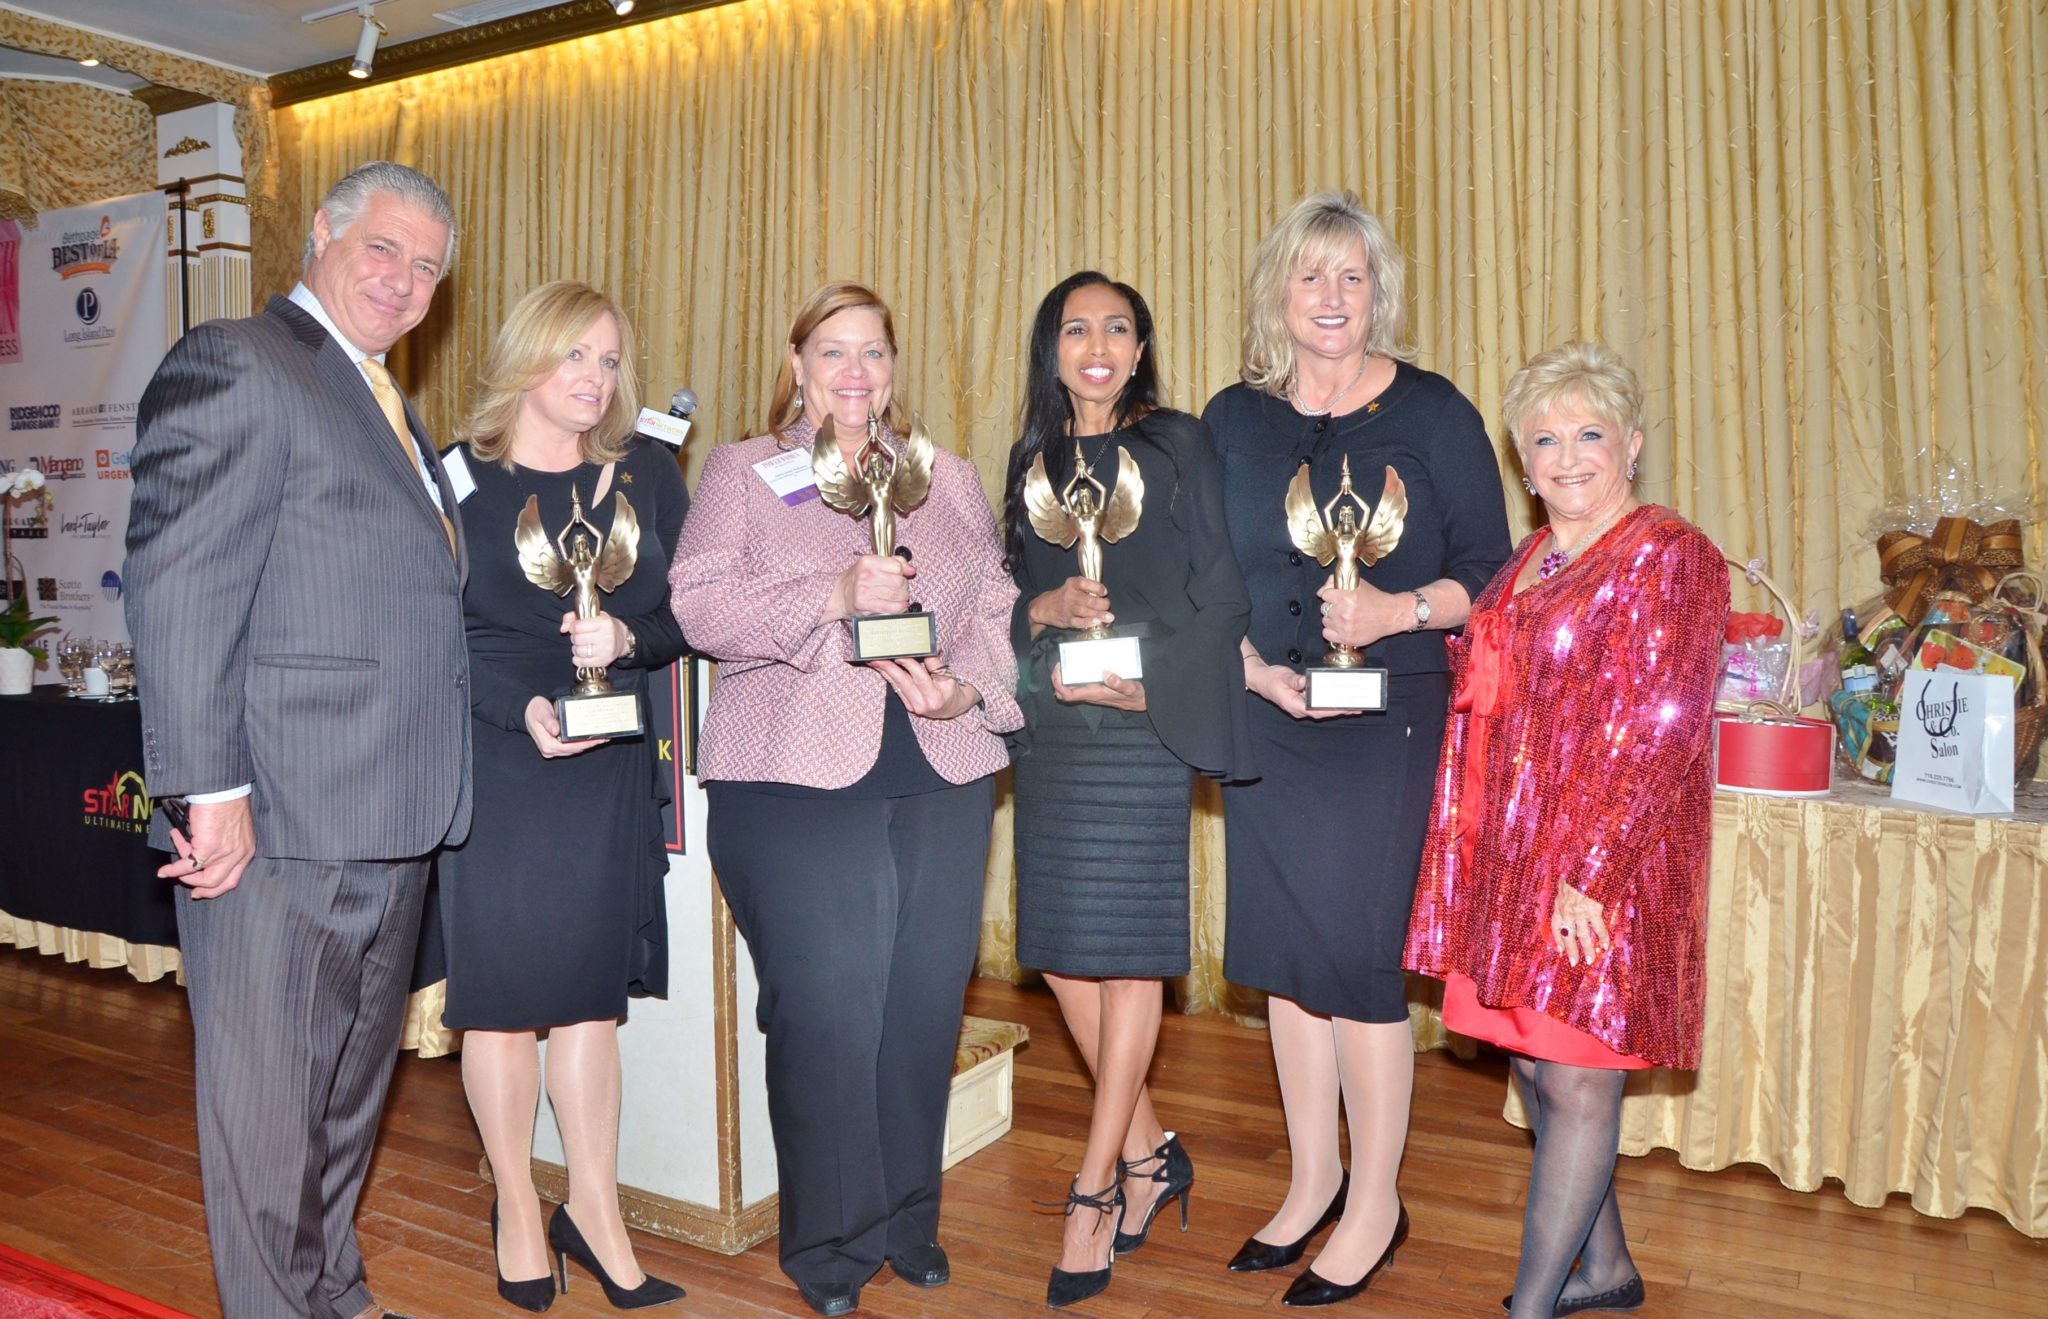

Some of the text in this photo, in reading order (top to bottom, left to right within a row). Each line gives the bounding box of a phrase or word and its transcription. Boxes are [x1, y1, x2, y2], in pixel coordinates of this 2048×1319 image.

[51, 242, 89, 271] BEST
[64, 328, 82, 343] Long
[81, 326, 102, 341] Island
[9, 404, 60, 420] RIDGEWOOD
[108, 402, 138, 413] FENST
[61, 513, 111, 538] Lord Taylor
[1930, 738, 1959, 759] Salon
[84, 815, 131, 832] ULTIMATE
